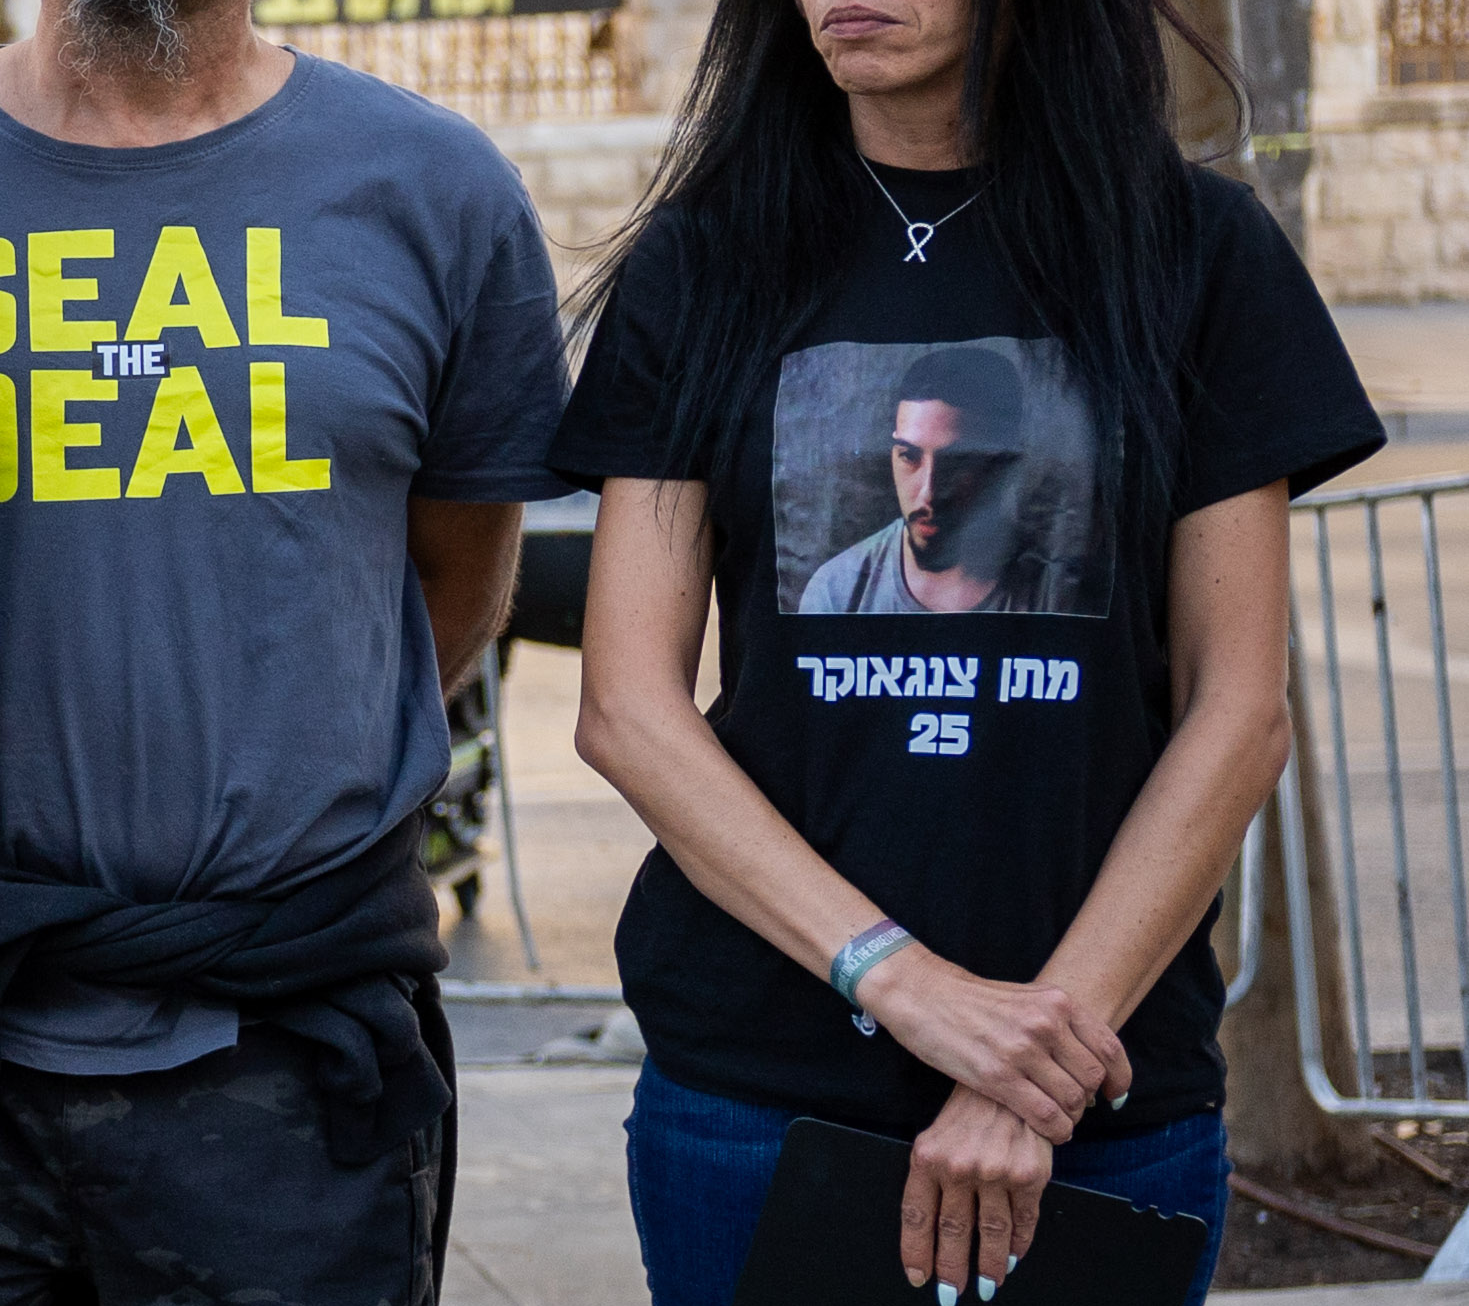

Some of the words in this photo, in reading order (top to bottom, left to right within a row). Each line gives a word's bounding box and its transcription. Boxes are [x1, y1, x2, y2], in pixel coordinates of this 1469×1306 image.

[96, 342, 166, 377] THE
[797, 656, 979, 702] צנגאוקר
[999, 658, 1079, 702] מתן
[908, 712, 971, 756] 25
